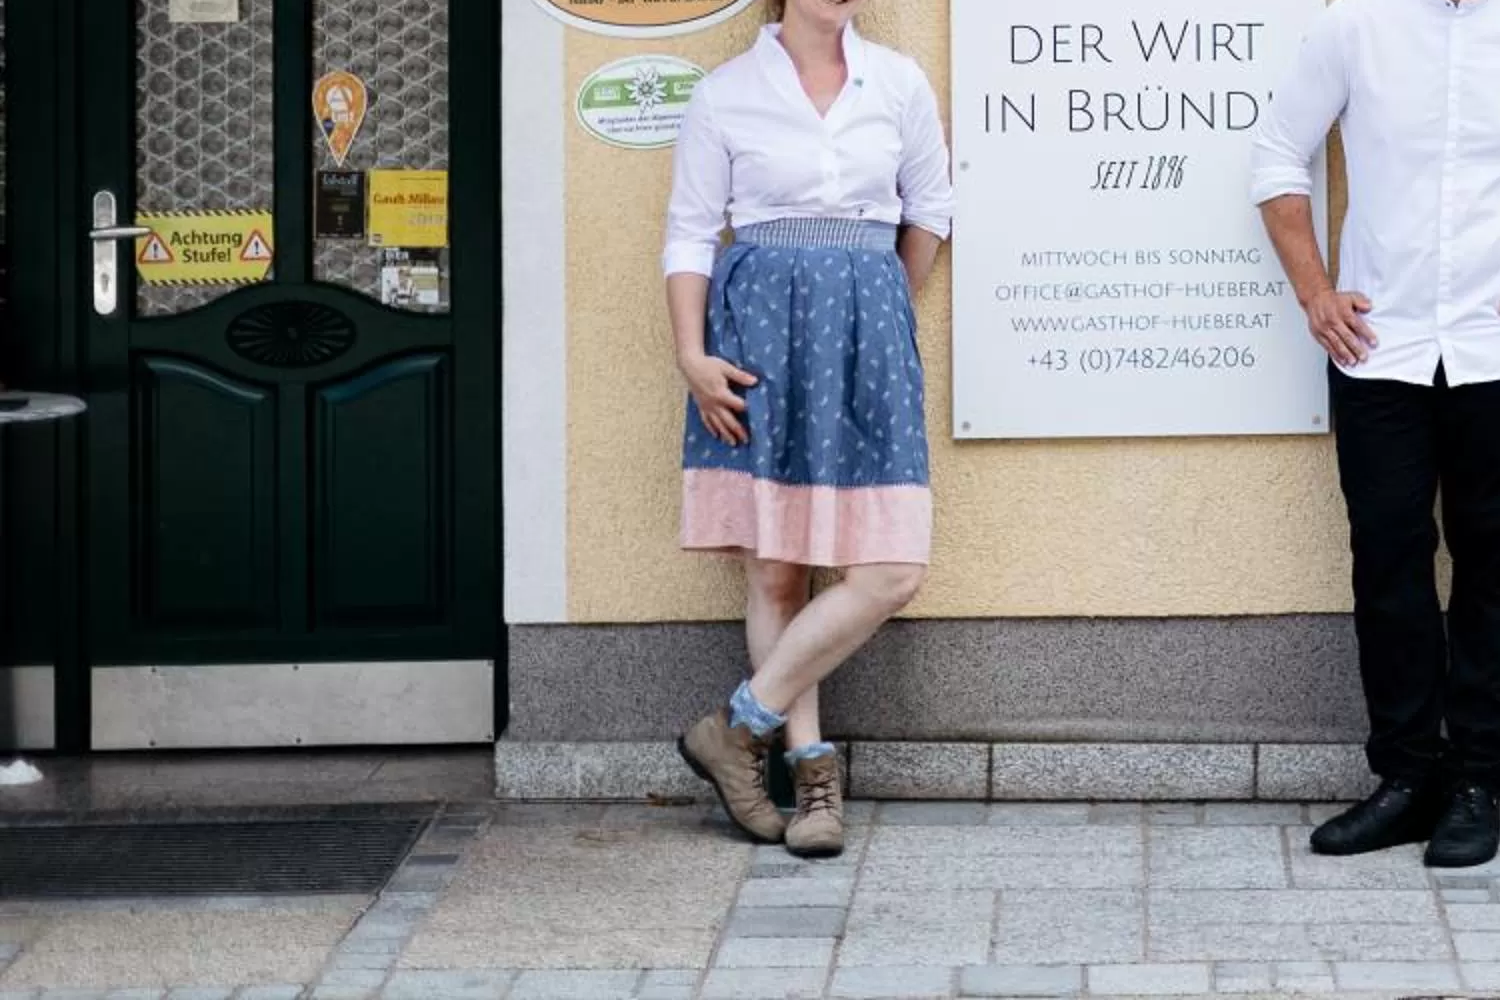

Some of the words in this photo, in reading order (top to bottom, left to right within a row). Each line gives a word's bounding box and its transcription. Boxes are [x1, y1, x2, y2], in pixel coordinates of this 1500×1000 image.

[1010, 24, 1112, 64] DER
[1132, 19, 1264, 63] WIRT
[985, 93, 1036, 133] IN
[1068, 85, 1273, 133] BRÜND
[1090, 160, 1139, 191] SEIT
[1139, 155, 1188, 191] 1896
[170, 229, 242, 246] Achtung
[182, 247, 231, 263] Stufe!
[1021, 250, 1128, 266] MITTWOCH
[1135, 249, 1161, 265] BIS
[1168, 248, 1263, 265] SONNTAG
[1028, 349, 1068, 371] +43
[1079, 345, 1255, 374] (0)7482/46206
